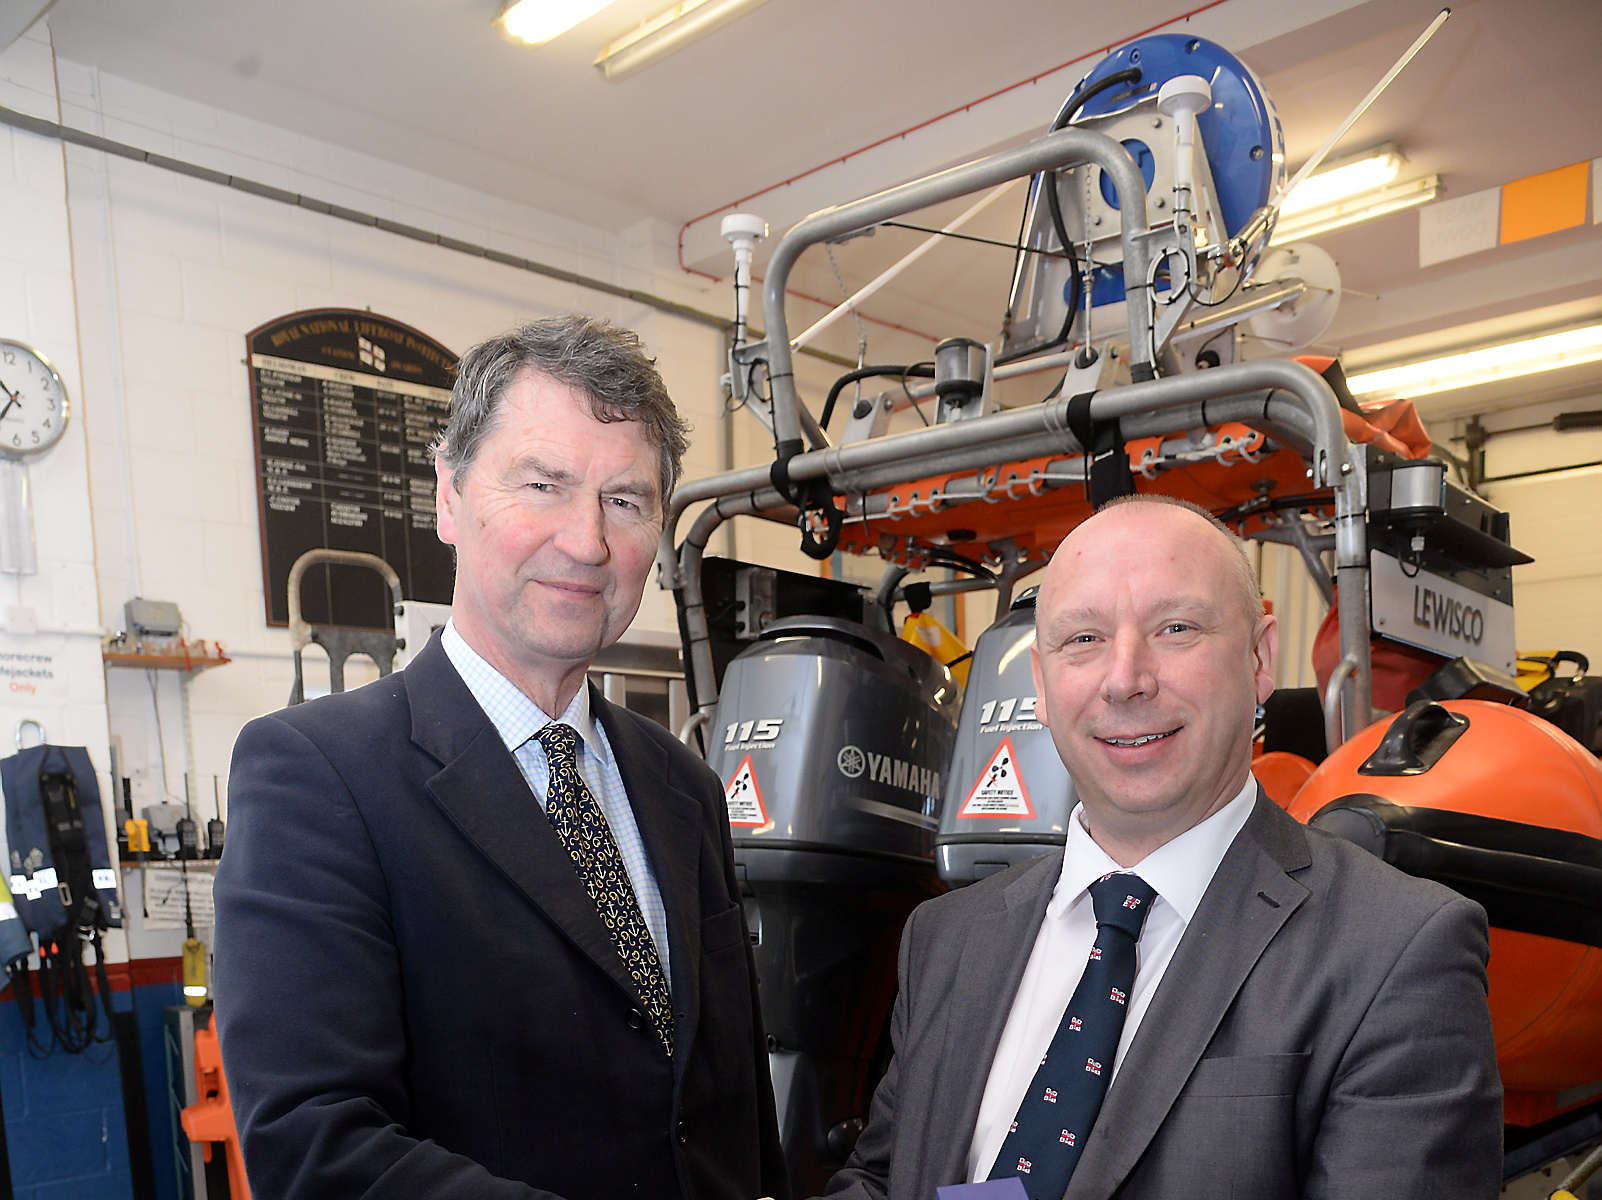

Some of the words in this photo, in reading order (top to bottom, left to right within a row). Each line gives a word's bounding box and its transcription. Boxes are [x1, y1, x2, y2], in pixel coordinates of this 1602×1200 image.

[3, 350, 16, 366] 12
[27, 361, 33, 374] 1
[40, 377, 50, 391] 2
[47, 398, 56, 411] 3
[42, 417, 51, 428] 4
[12, 433, 21, 447] 6
[31, 430, 40, 444] 5
[1413, 584, 1484, 646] LEWISCO
[9, 681, 37, 695] Only
[979, 696, 1038, 724] 115
[724, 718, 784, 743] 115
[979, 723, 999, 734] Fuel
[999, 719, 1044, 733] Injection
[724, 742, 740, 752] Fuel
[740, 740, 776, 751] Injection
[866, 751, 941, 800] YAMAHA
